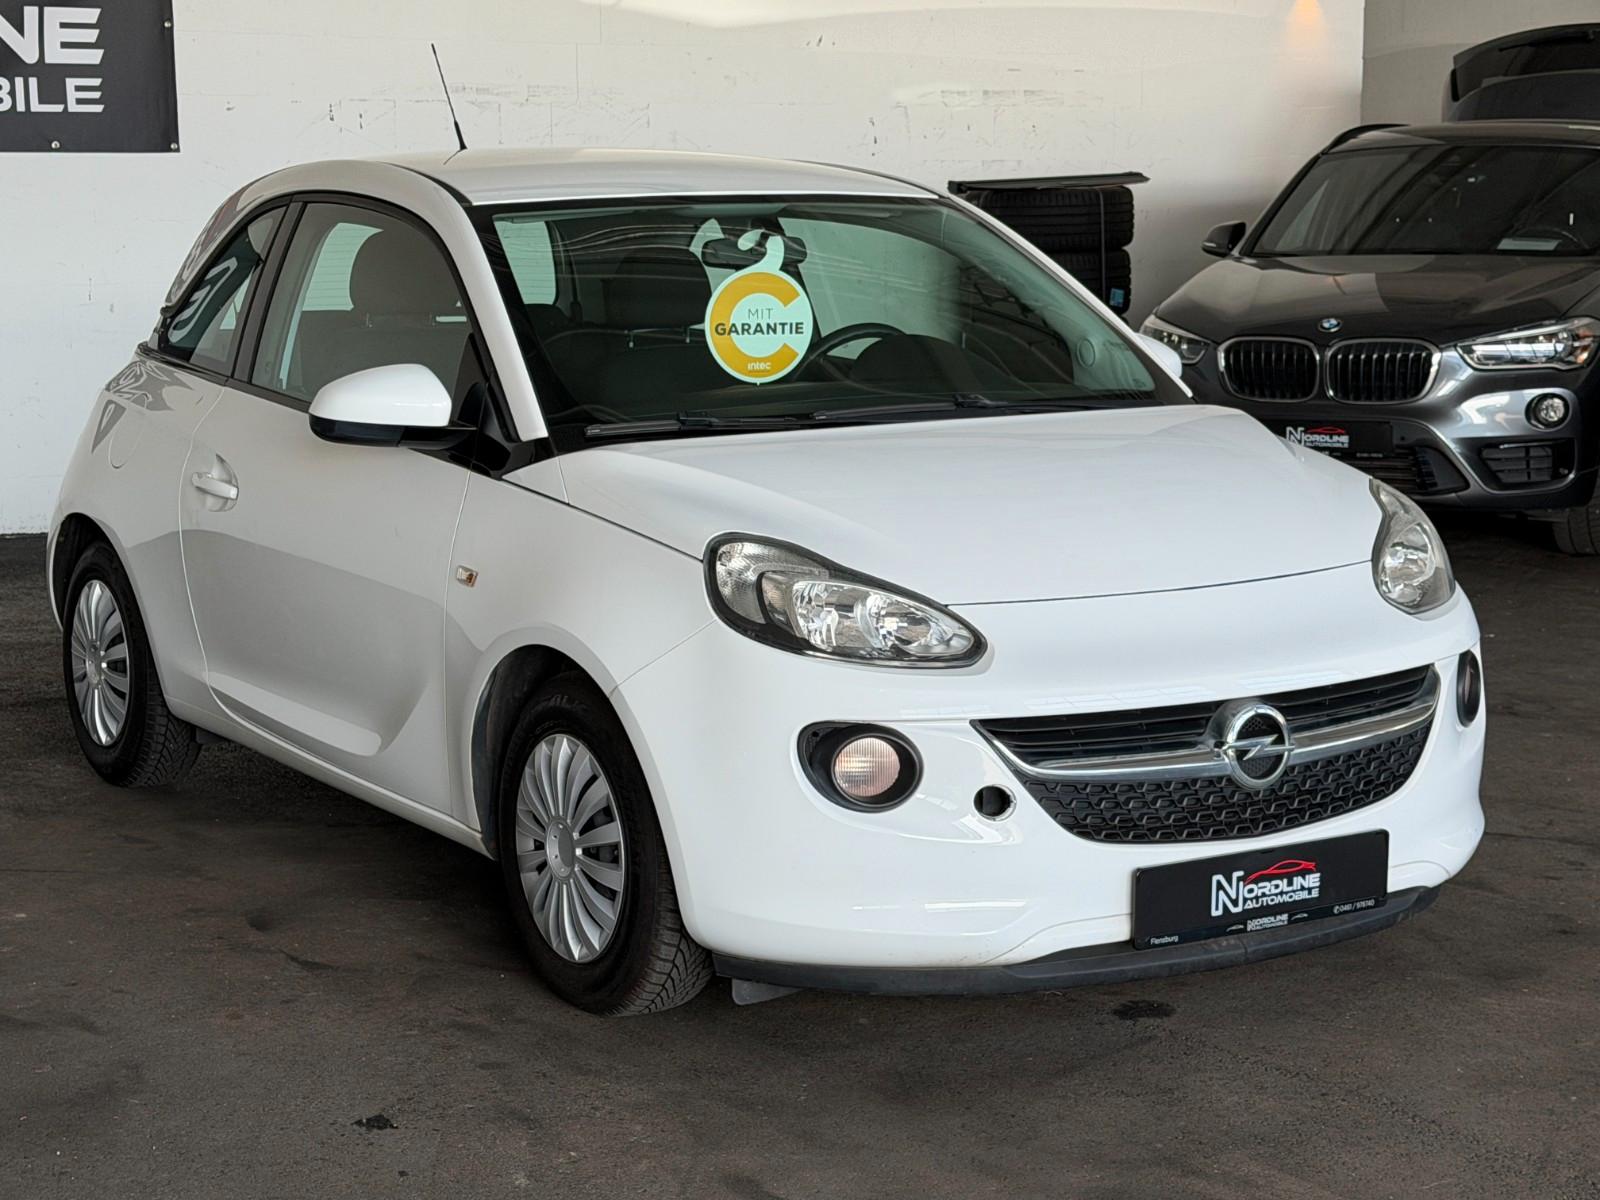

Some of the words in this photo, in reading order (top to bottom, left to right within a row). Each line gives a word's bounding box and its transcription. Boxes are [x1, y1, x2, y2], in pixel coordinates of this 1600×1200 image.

[748, 308, 773, 321] MIT
[714, 322, 805, 336] GARANTIE
[747, 361, 772, 371] intec
[1286, 426, 1349, 446] NORDLINE
[1211, 870, 1321, 917] NORDLINE
[1243, 888, 1320, 910] AUTOMOBILE
